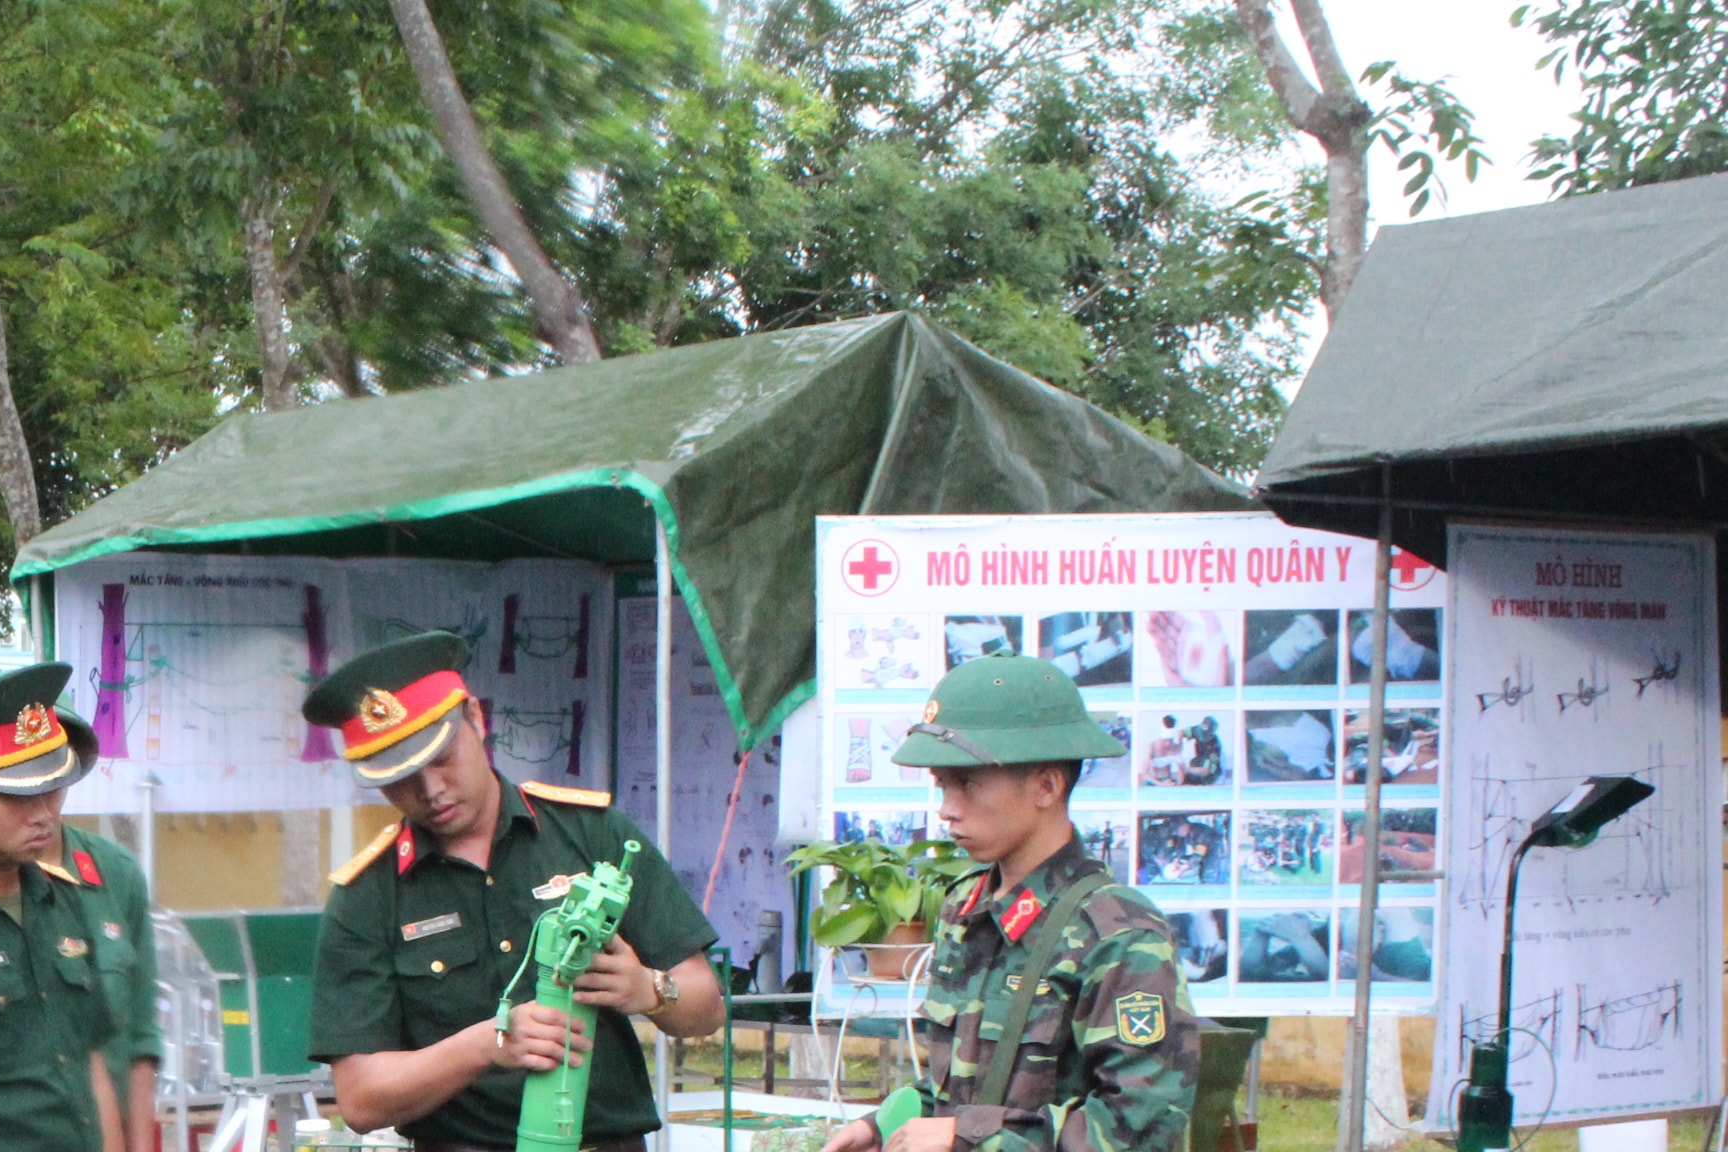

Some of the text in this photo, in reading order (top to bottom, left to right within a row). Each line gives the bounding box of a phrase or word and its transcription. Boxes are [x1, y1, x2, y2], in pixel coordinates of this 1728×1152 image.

[926, 536, 1353, 592] MÔ HÌNH HUẤN LUYỆN QUÂN Y
[1535, 555, 1623, 588] MÔ HÌNH
